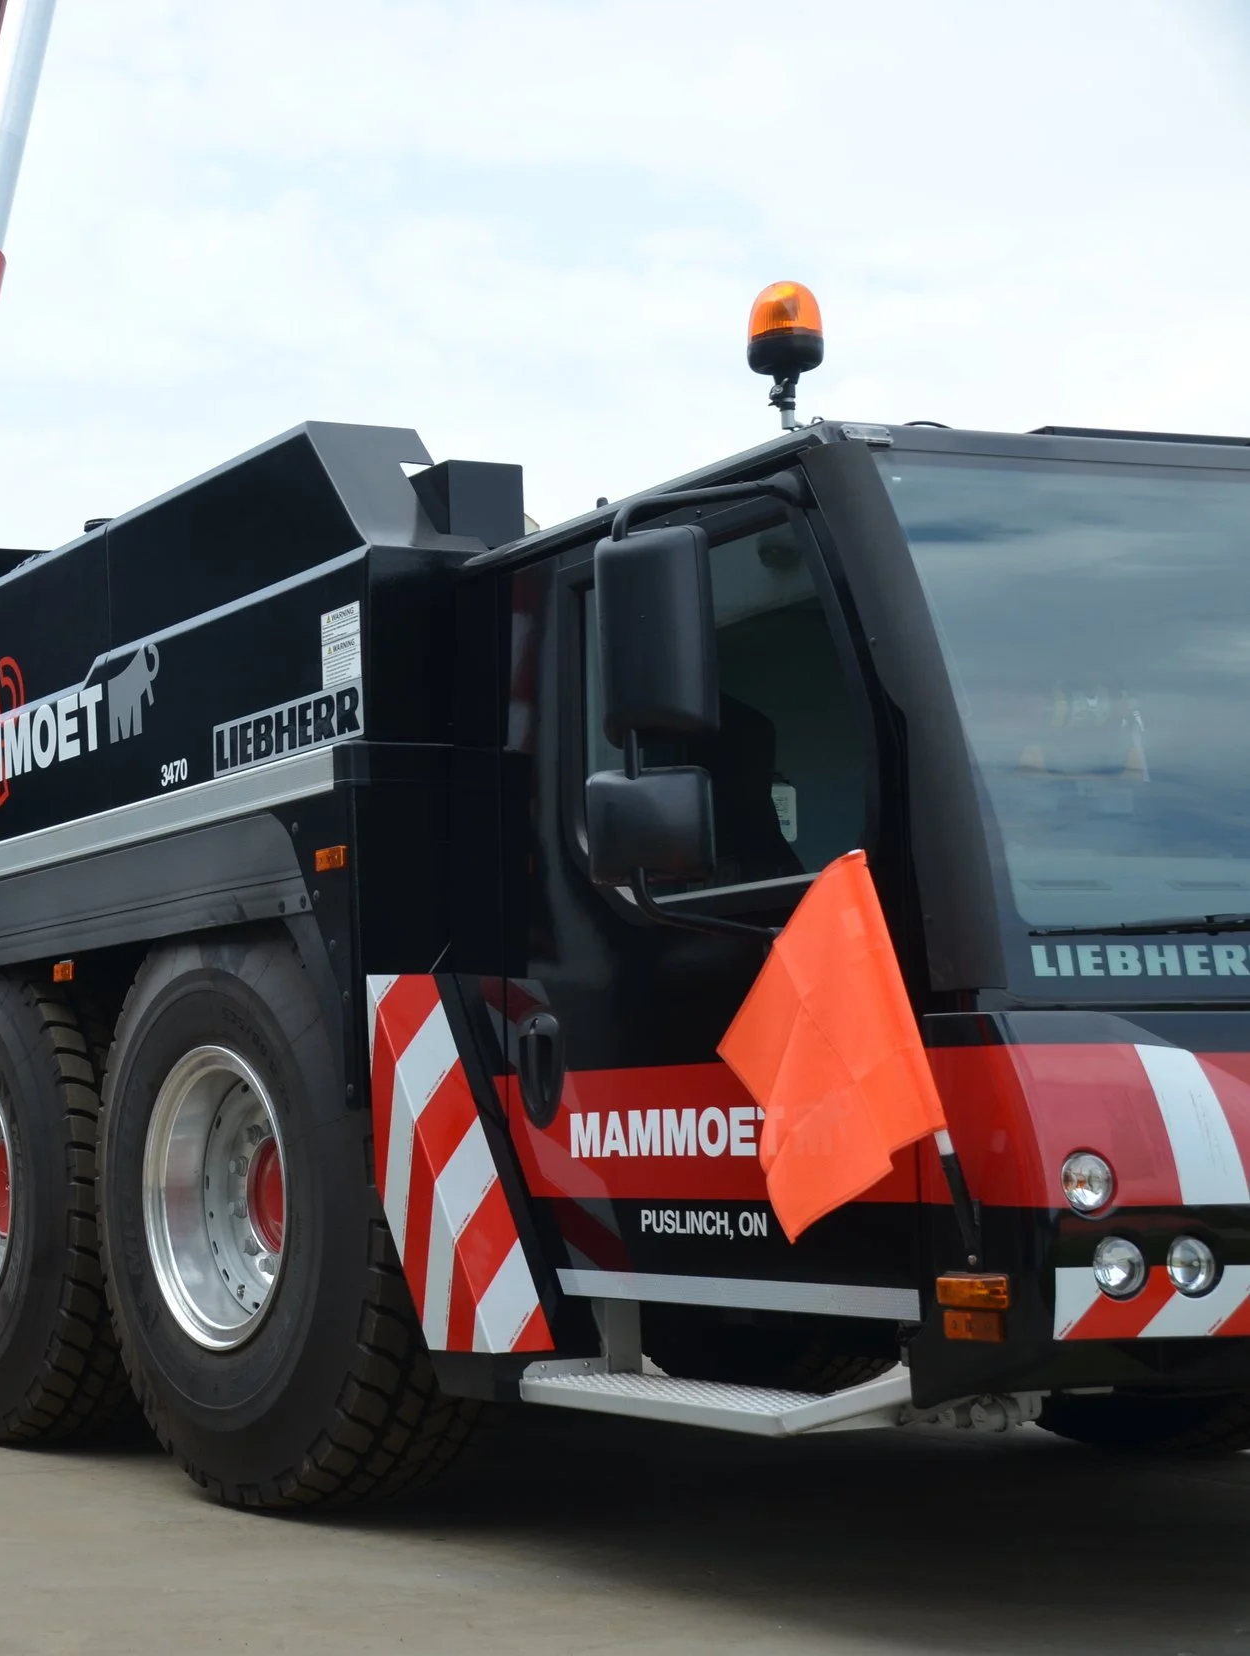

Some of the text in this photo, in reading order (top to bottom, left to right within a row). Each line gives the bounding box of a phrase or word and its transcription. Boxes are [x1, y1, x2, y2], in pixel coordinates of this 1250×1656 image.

[331, 606, 355, 621] WARNING
[332, 638, 355, 653] WARNING
[215, 686, 361, 772] LIEBHERR
[161, 758, 188, 787] 3470
[1030, 944, 1250, 977] LIEBHER
[640, 1209, 768, 1240] PUSLINCH, ON
